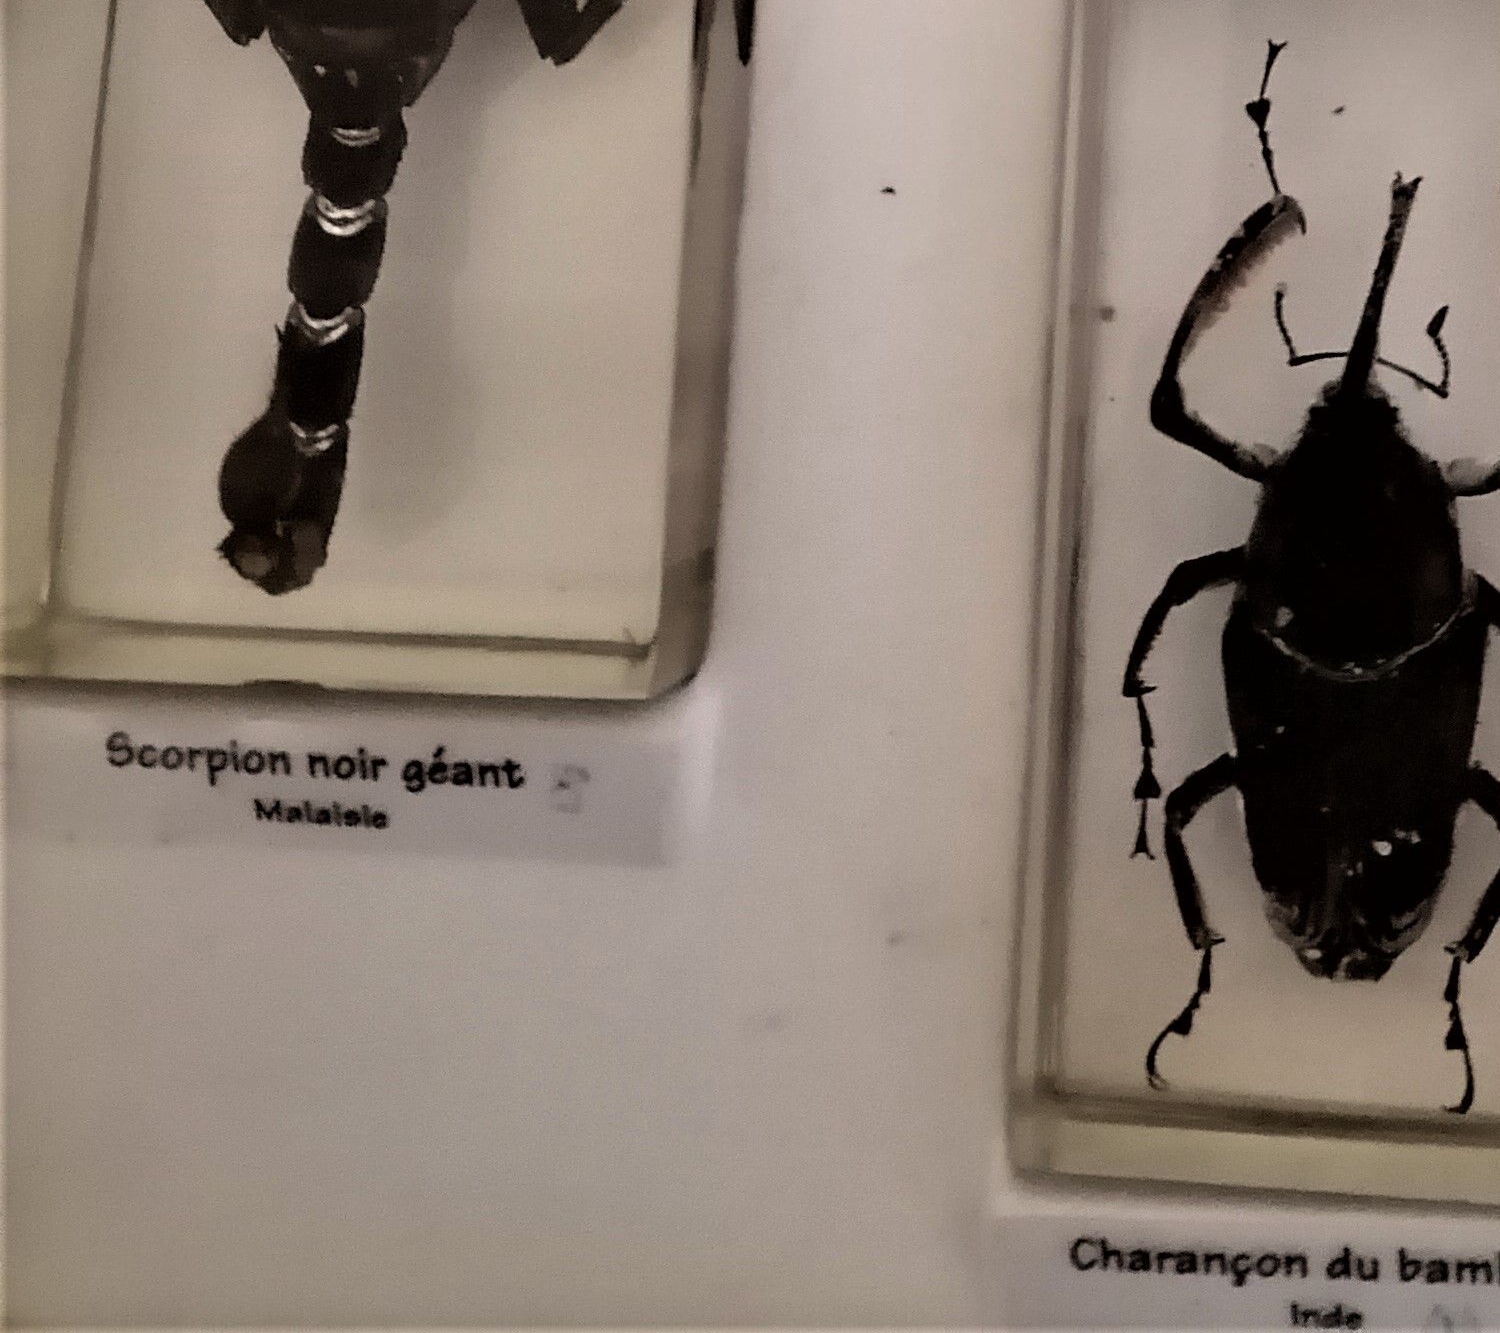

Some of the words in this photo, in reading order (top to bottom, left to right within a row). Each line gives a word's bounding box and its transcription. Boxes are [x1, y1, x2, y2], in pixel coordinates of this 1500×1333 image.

[105, 731, 291, 786] Scorpion
[306, 746, 389, 781] noir
[402, 746, 525, 793] géant
[252, 798, 390, 829] Malaisie
[1069, 1237, 1309, 1287] Charançon
[1325, 1247, 1379, 1282] du
[1289, 1301, 1365, 1330] Inde
